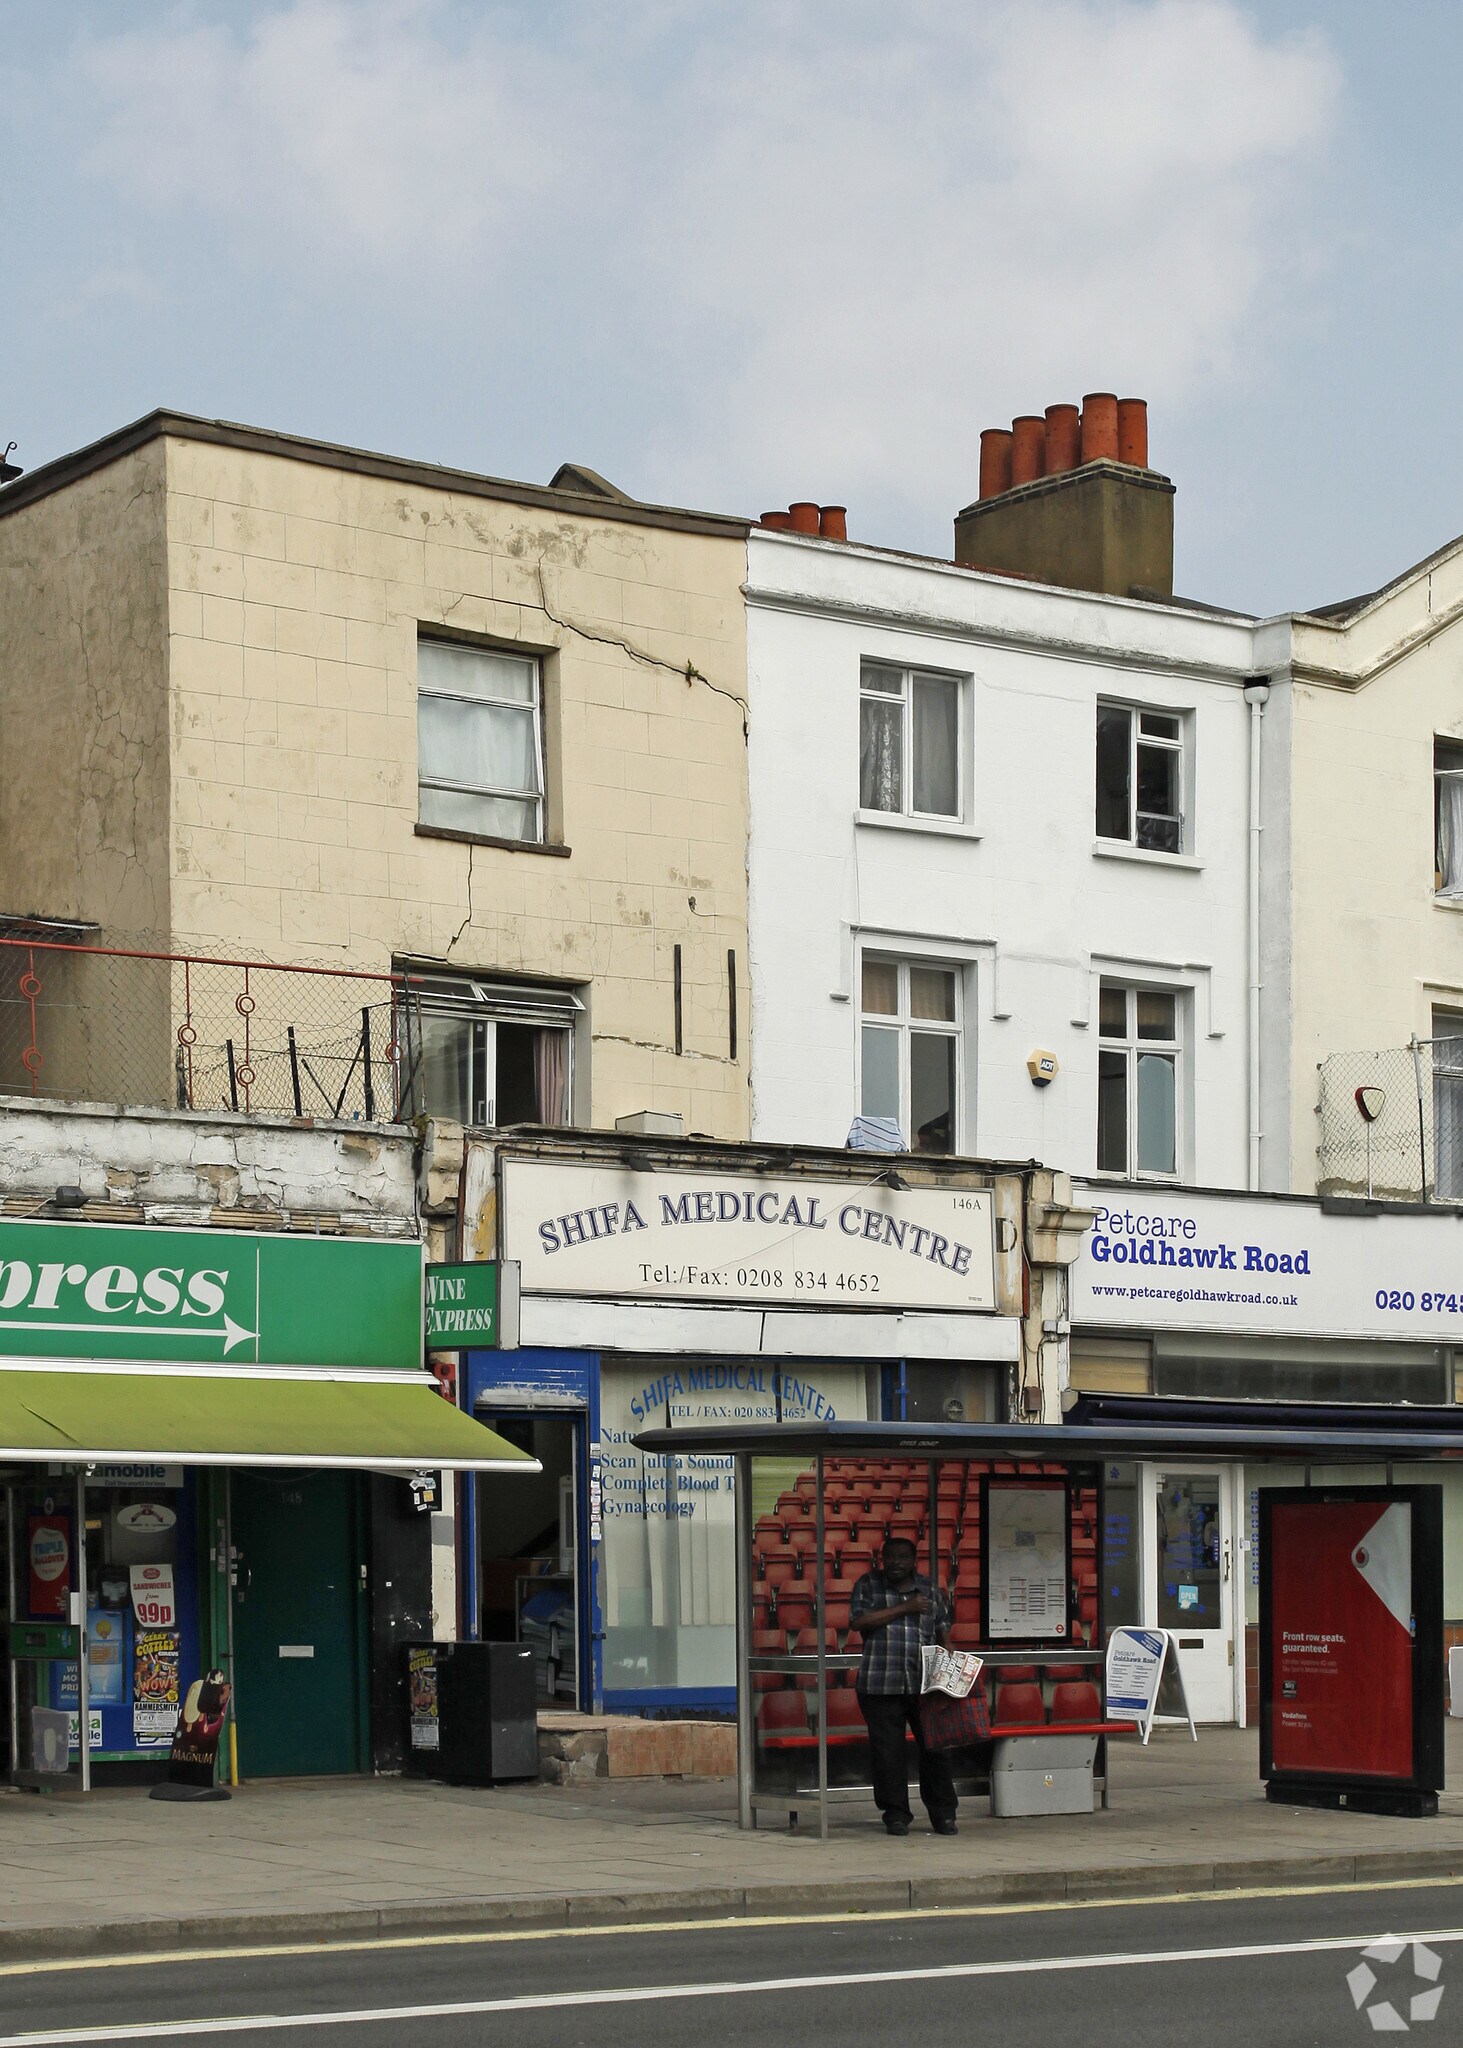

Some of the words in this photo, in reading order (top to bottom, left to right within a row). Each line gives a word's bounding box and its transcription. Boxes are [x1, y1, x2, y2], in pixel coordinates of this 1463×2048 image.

[1041, 1060, 1053, 1070] ADT
[952, 1197, 982, 1211] 146A
[1091, 1206, 1197, 1239] Petcare
[538, 1199, 648, 1254] SHIFA
[659, 1191, 827, 1230] MEDICAL
[839, 1204, 972, 1277] CENTRE
[1091, 1235, 1237, 1270] Goldhawk
[1243, 1246, 1311, 1275] Road
[0, 1260, 229, 1317] press
[737, 1268, 783, 1288] 0208
[794, 1271, 827, 1290] 834
[835, 1273, 880, 1292] 4652
[426, 1276, 465, 1304] WINE
[1091, 1286, 1298, 1306] www.petcaregoldhawkroad.co.uk
[1375, 1290, 1415, 1311] 020
[426, 1307, 493, 1336] EXPRESS
[631, 1370, 684, 1423] SHIFA
[688, 1364, 766, 1394] MEDICAL
[771, 1372, 836, 1421] CENTER
[670, 1405, 694, 1417] TEL
[704, 1406, 731, 1418] FAX:
[734, 1406, 753, 1418] 020
[782, 1406, 806, 1418] 4652
[601, 1428, 637, 1444] Natu
[601, 1453, 636, 1468] Scan
[688, 1454, 734, 1469] Sound
[602, 1474, 674, 1494] Complete
[678, 1475, 719, 1491] Blood
[602, 1498, 697, 1517] Gynaecology
[133, 1582, 171, 1591] SANDWICHES
[1181, 1592, 1197, 1600] OPEN
[137, 1602, 171, 1625] 99p
[1283, 1631, 1304, 1641] Front
[1321, 1634, 1346, 1643] seats,
[1282, 1644, 1330, 1653] guaranteed.
[135, 1702, 178, 1712] HAMMERSMITH
[1282, 1711, 1307, 1719] Vodafone
[172, 1749, 213, 1764] MAGNUM
